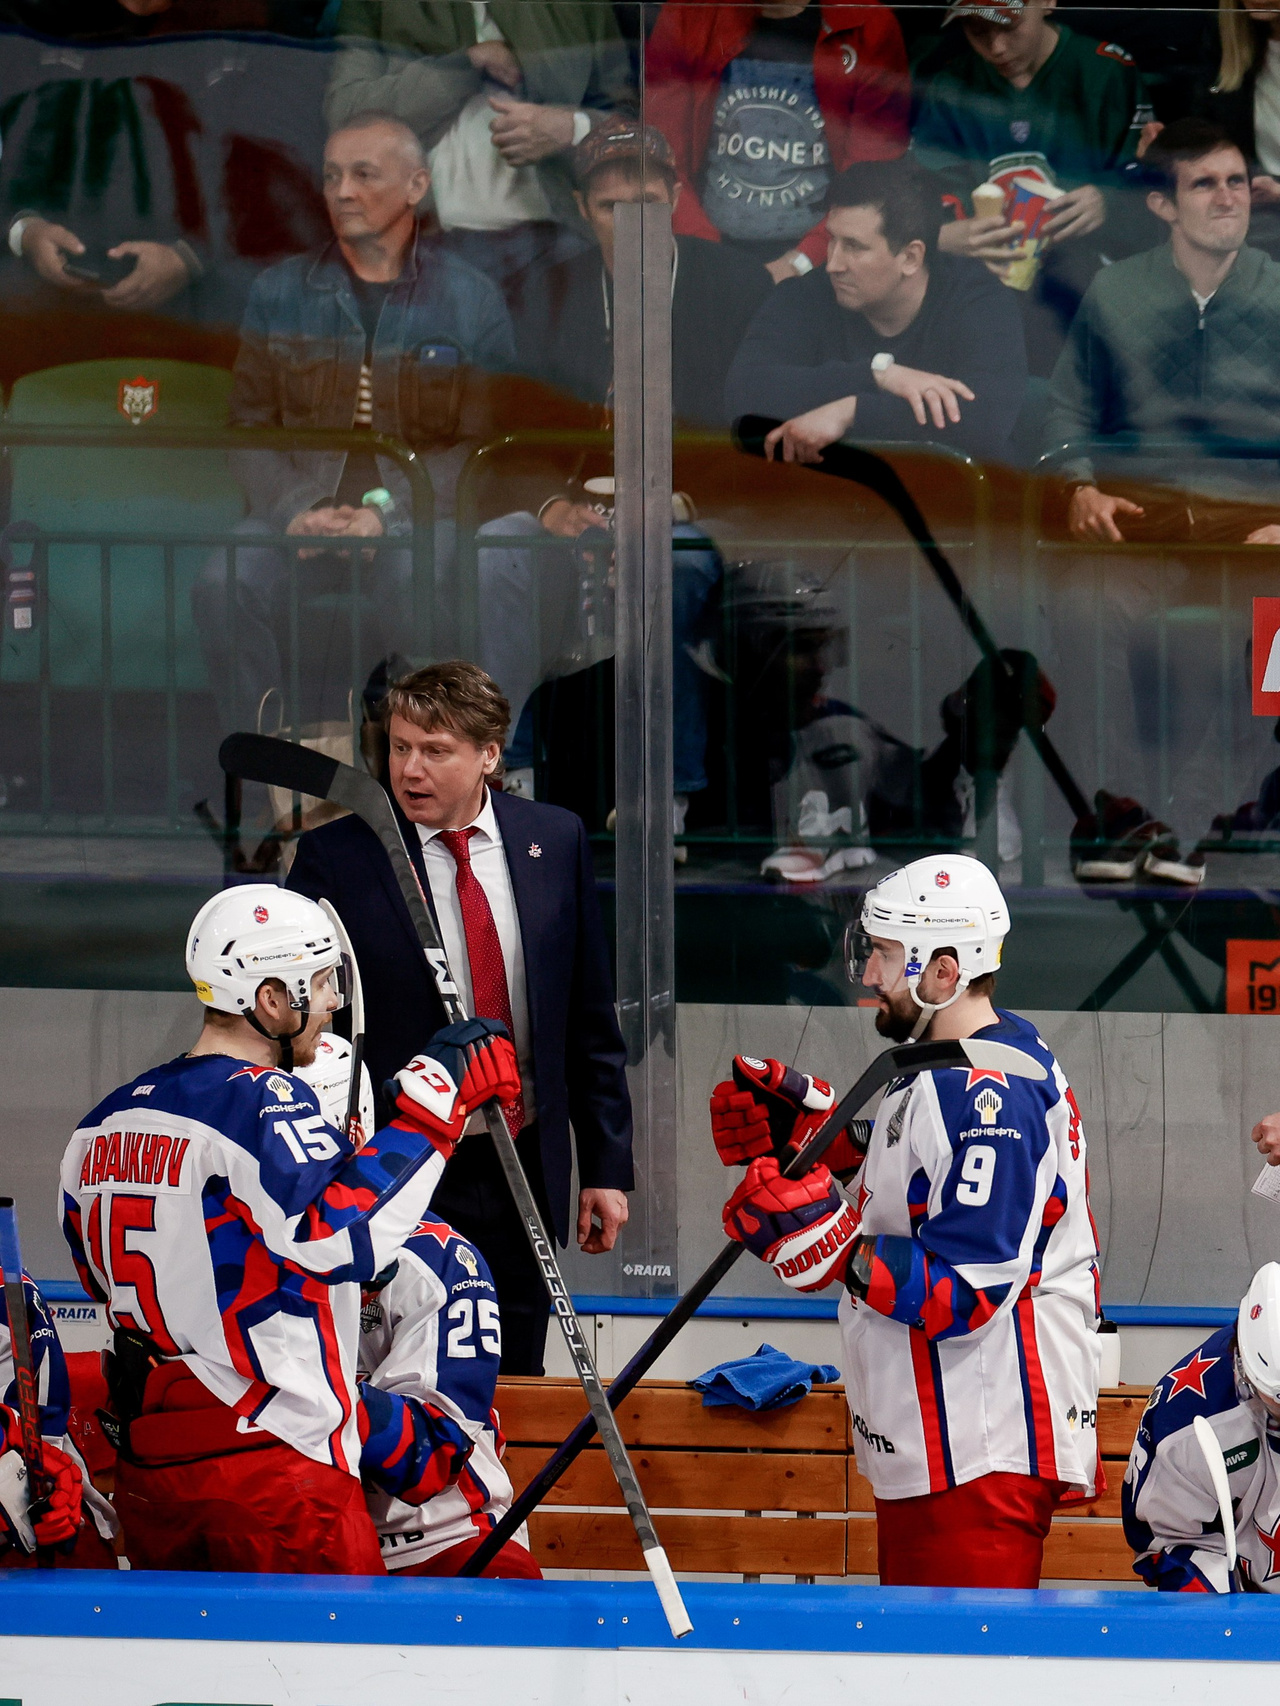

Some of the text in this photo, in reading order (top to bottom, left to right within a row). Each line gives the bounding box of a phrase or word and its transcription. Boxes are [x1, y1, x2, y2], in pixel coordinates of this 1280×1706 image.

[717, 133, 825, 166] BOGNER
[717, 173, 815, 206] MUNICH
[273, 1115, 341, 1164] 15
[956, 1144, 997, 1207] 9
[86, 1192, 183, 1357] 15
[633, 1264, 672, 1277] RAITA
[56, 1307, 97, 1320] RAITA
[446, 1298, 502, 1359] 25
[1224, 1450, 1249, 1467] МИР
